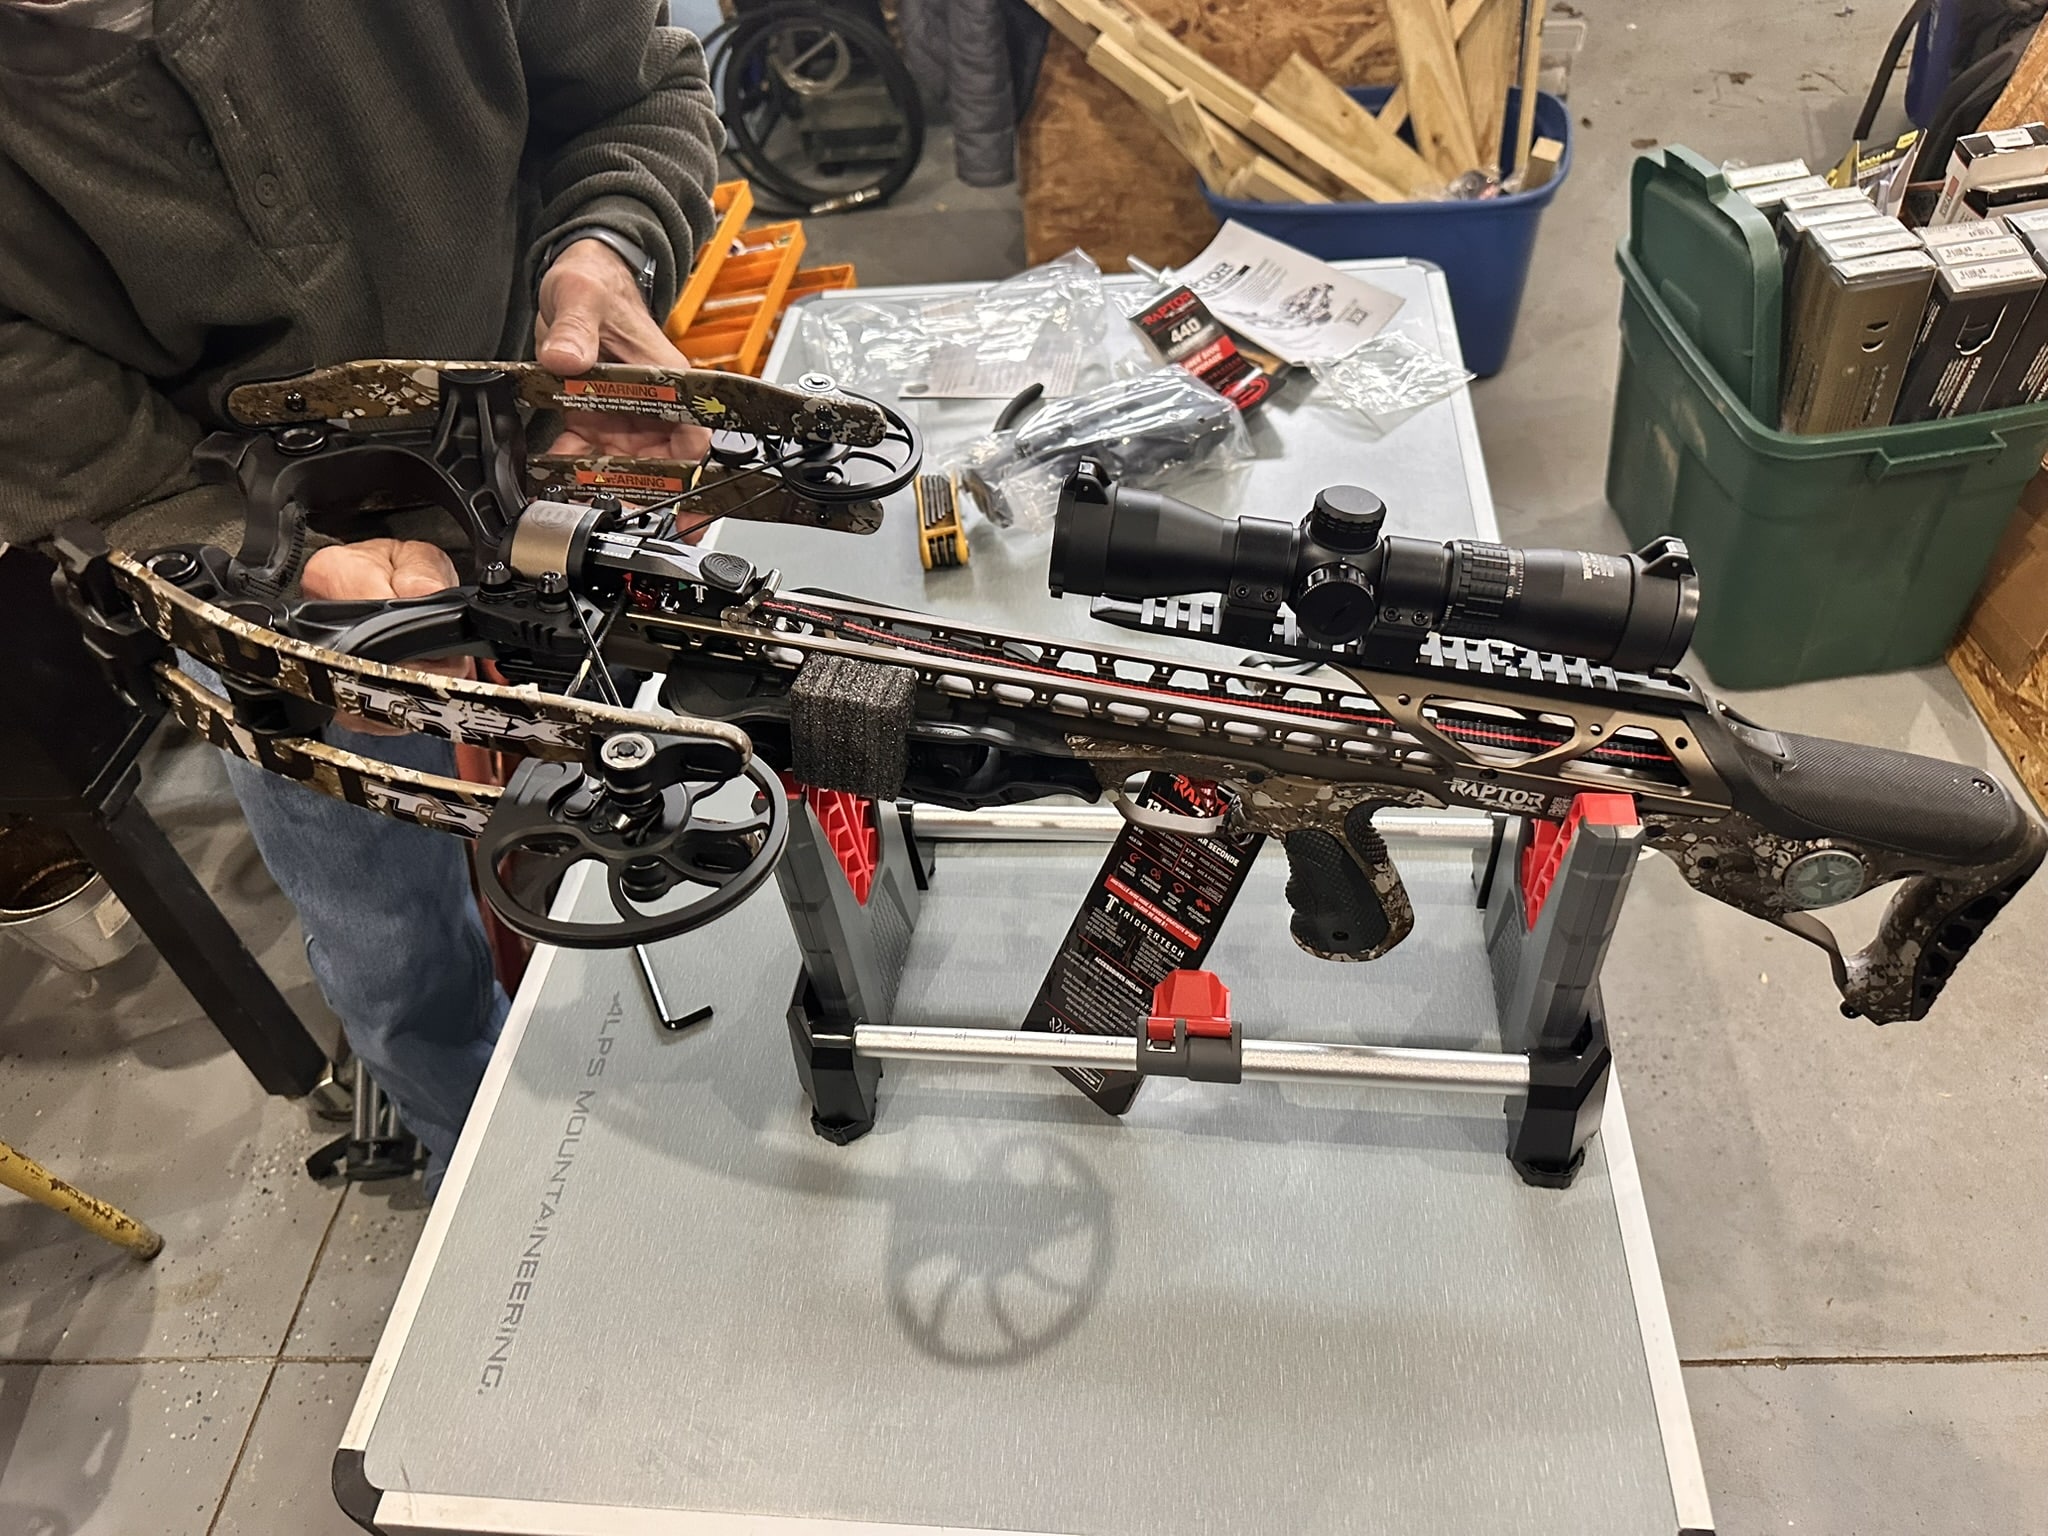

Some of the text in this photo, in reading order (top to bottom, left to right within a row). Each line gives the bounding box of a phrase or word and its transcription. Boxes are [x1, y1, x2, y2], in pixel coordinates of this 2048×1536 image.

[1193, 263, 1233, 290] PTOR
[1142, 290, 1193, 326] RAPTOR
[1169, 317, 1200, 343] 440
[588, 395, 607, 403] thumb
[620, 398, 639, 406] fingers
[594, 382, 658, 397] WARNING
[335, 678, 584, 750] T-REX
[1444, 777, 1545, 809] RAPTOR
[1158, 842, 1178, 858] PUISSANCE
[1208, 842, 1240, 867] SECONDE
[1132, 900, 1148, 914] VALEUR
[1117, 906, 1185, 958] TRIGGERTECH
[1094, 956, 1143, 995] ACCESSOIRES INCLUS
[586, 990, 624, 1079] ALPS
